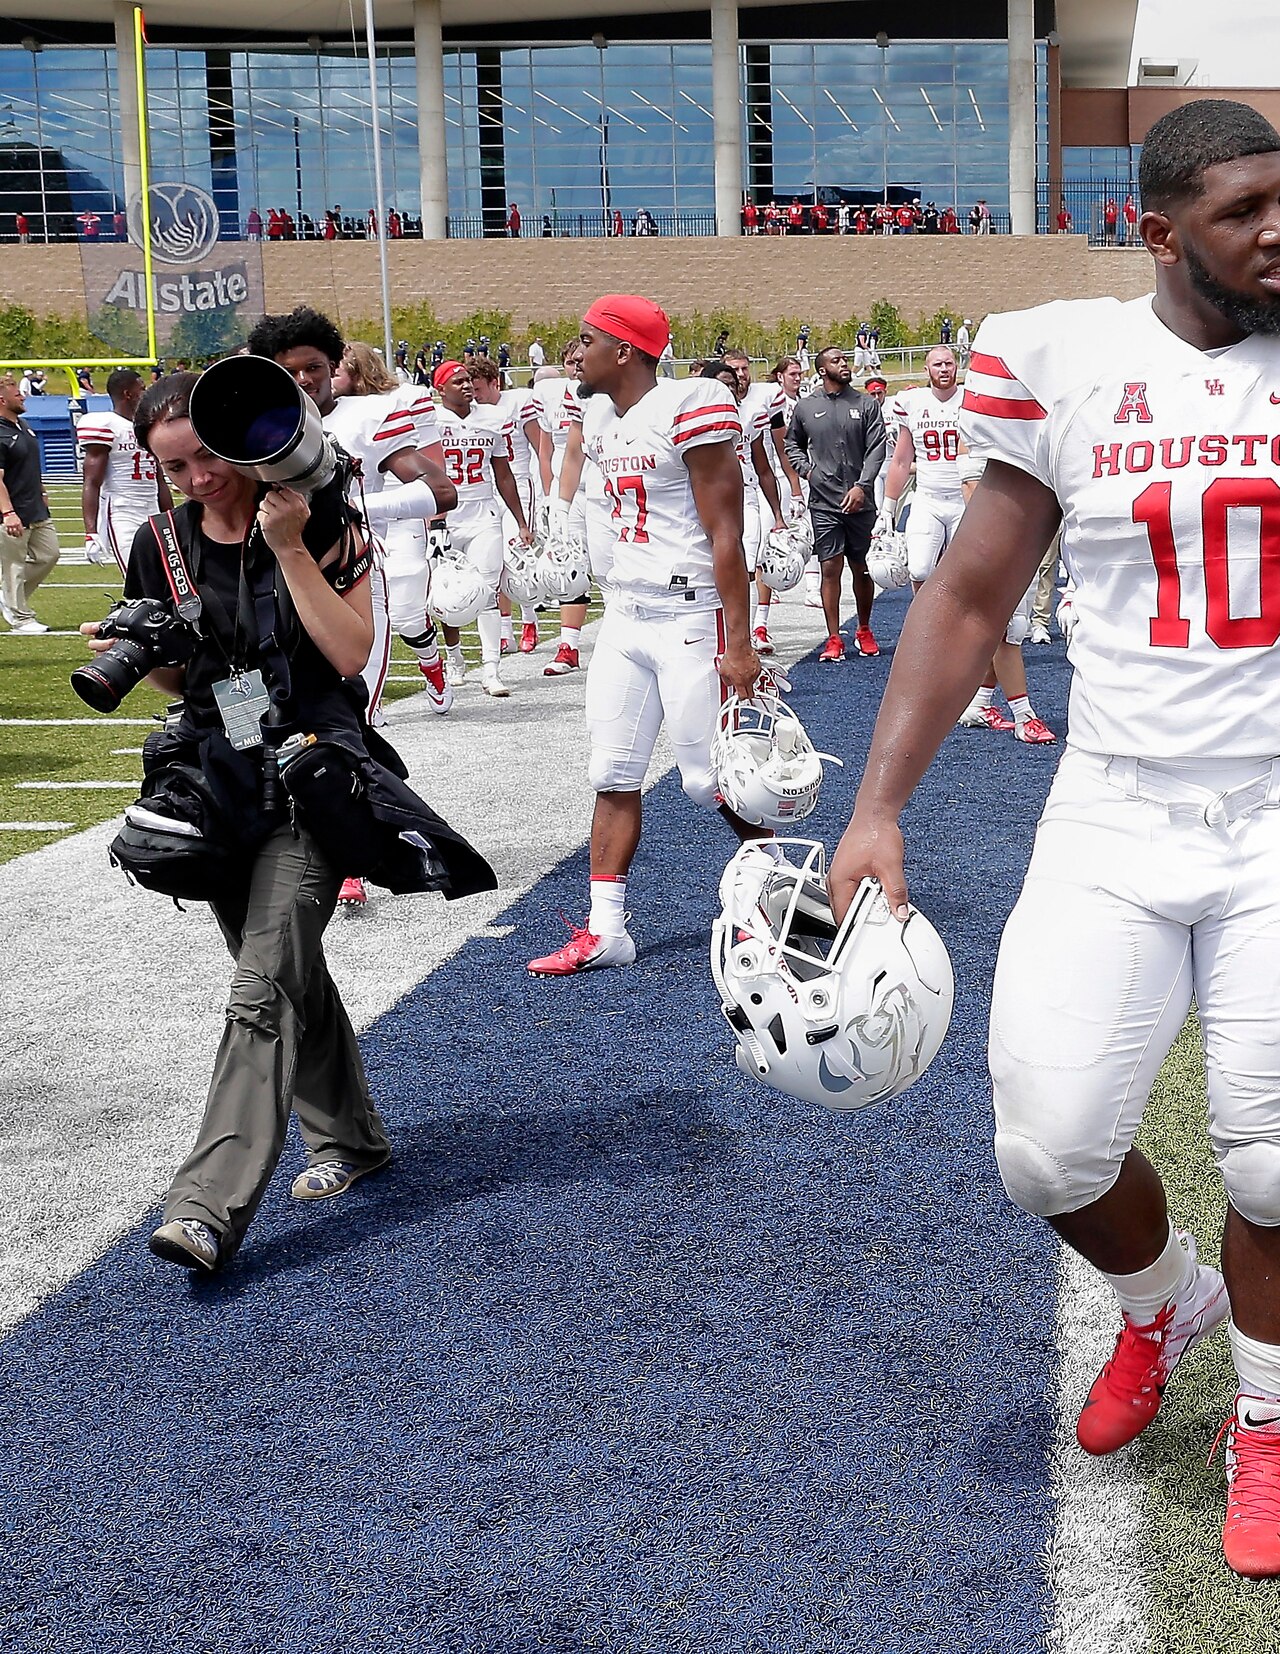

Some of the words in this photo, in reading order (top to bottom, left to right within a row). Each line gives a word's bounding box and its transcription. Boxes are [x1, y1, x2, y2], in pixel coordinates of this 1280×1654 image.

[105, 271, 247, 313] Allstate
[917, 420, 959, 429] HOUSTO
[441, 437, 495, 448] OUSTON
[923, 429, 960, 461] 90
[445, 448, 485, 486] 32
[335, 557, 368, 589] Cnon
[243, 734, 262, 746] MED
[782, 775, 822, 796] OUSTON
